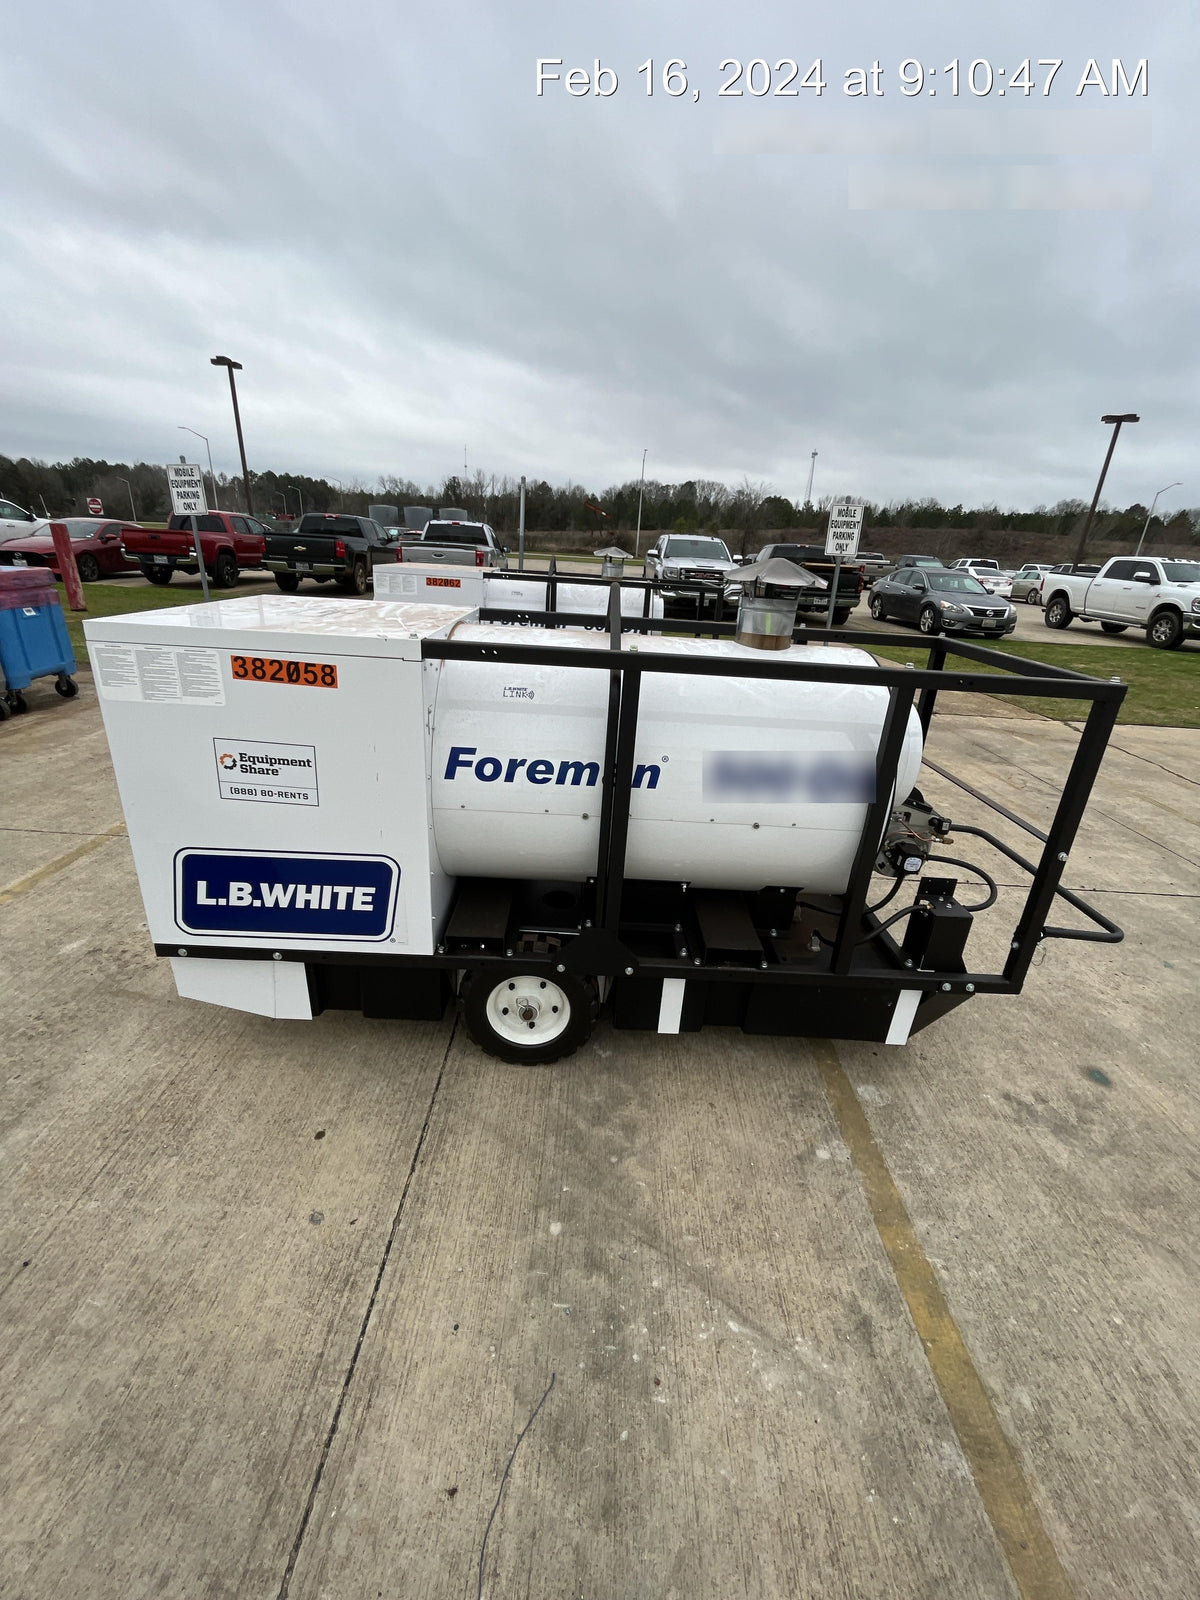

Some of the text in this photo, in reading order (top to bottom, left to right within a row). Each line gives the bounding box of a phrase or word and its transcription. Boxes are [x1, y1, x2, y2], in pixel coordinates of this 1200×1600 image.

[174, 467, 195, 477] MOBILE
[171, 479, 201, 489] EQUIPMENT
[177, 490, 201, 500] PARKING
[182, 501, 198, 511] ONLY
[837, 508, 857, 518] MOBILE
[830, 519, 861, 530] EQUIPMENT
[832, 531, 855, 541] PARKING
[835, 542, 850, 552] ONLY
[233, 655, 336, 687] 382058
[502, 690, 528, 699] LINK
[238, 752, 313, 768] Equipment
[239, 763, 280, 776] Share
[444, 746, 662, 790] Foremn
[229, 786, 309, 800] (888) 80-RENTS
[196, 880, 376, 911] L.B.WHITE
